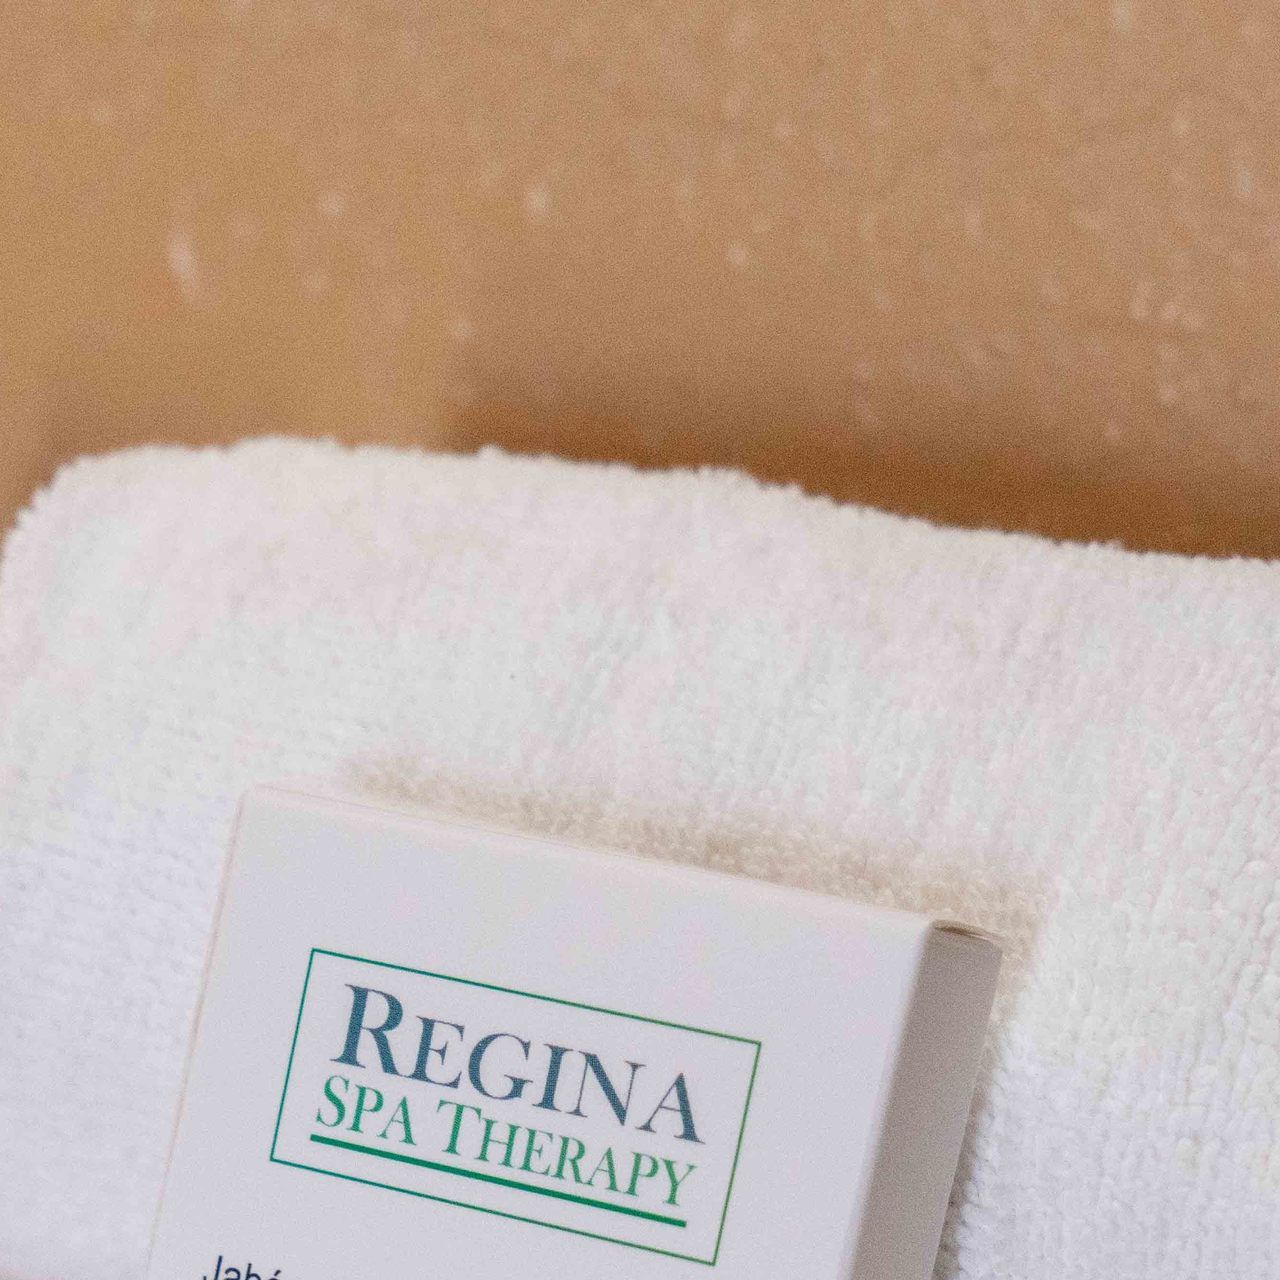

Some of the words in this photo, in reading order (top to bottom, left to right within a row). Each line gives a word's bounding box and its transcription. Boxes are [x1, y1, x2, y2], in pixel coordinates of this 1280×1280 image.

[329, 984, 707, 1145] REGINA
[315, 1074, 418, 1146] SPA
[436, 1099, 698, 1206] THERAPY
